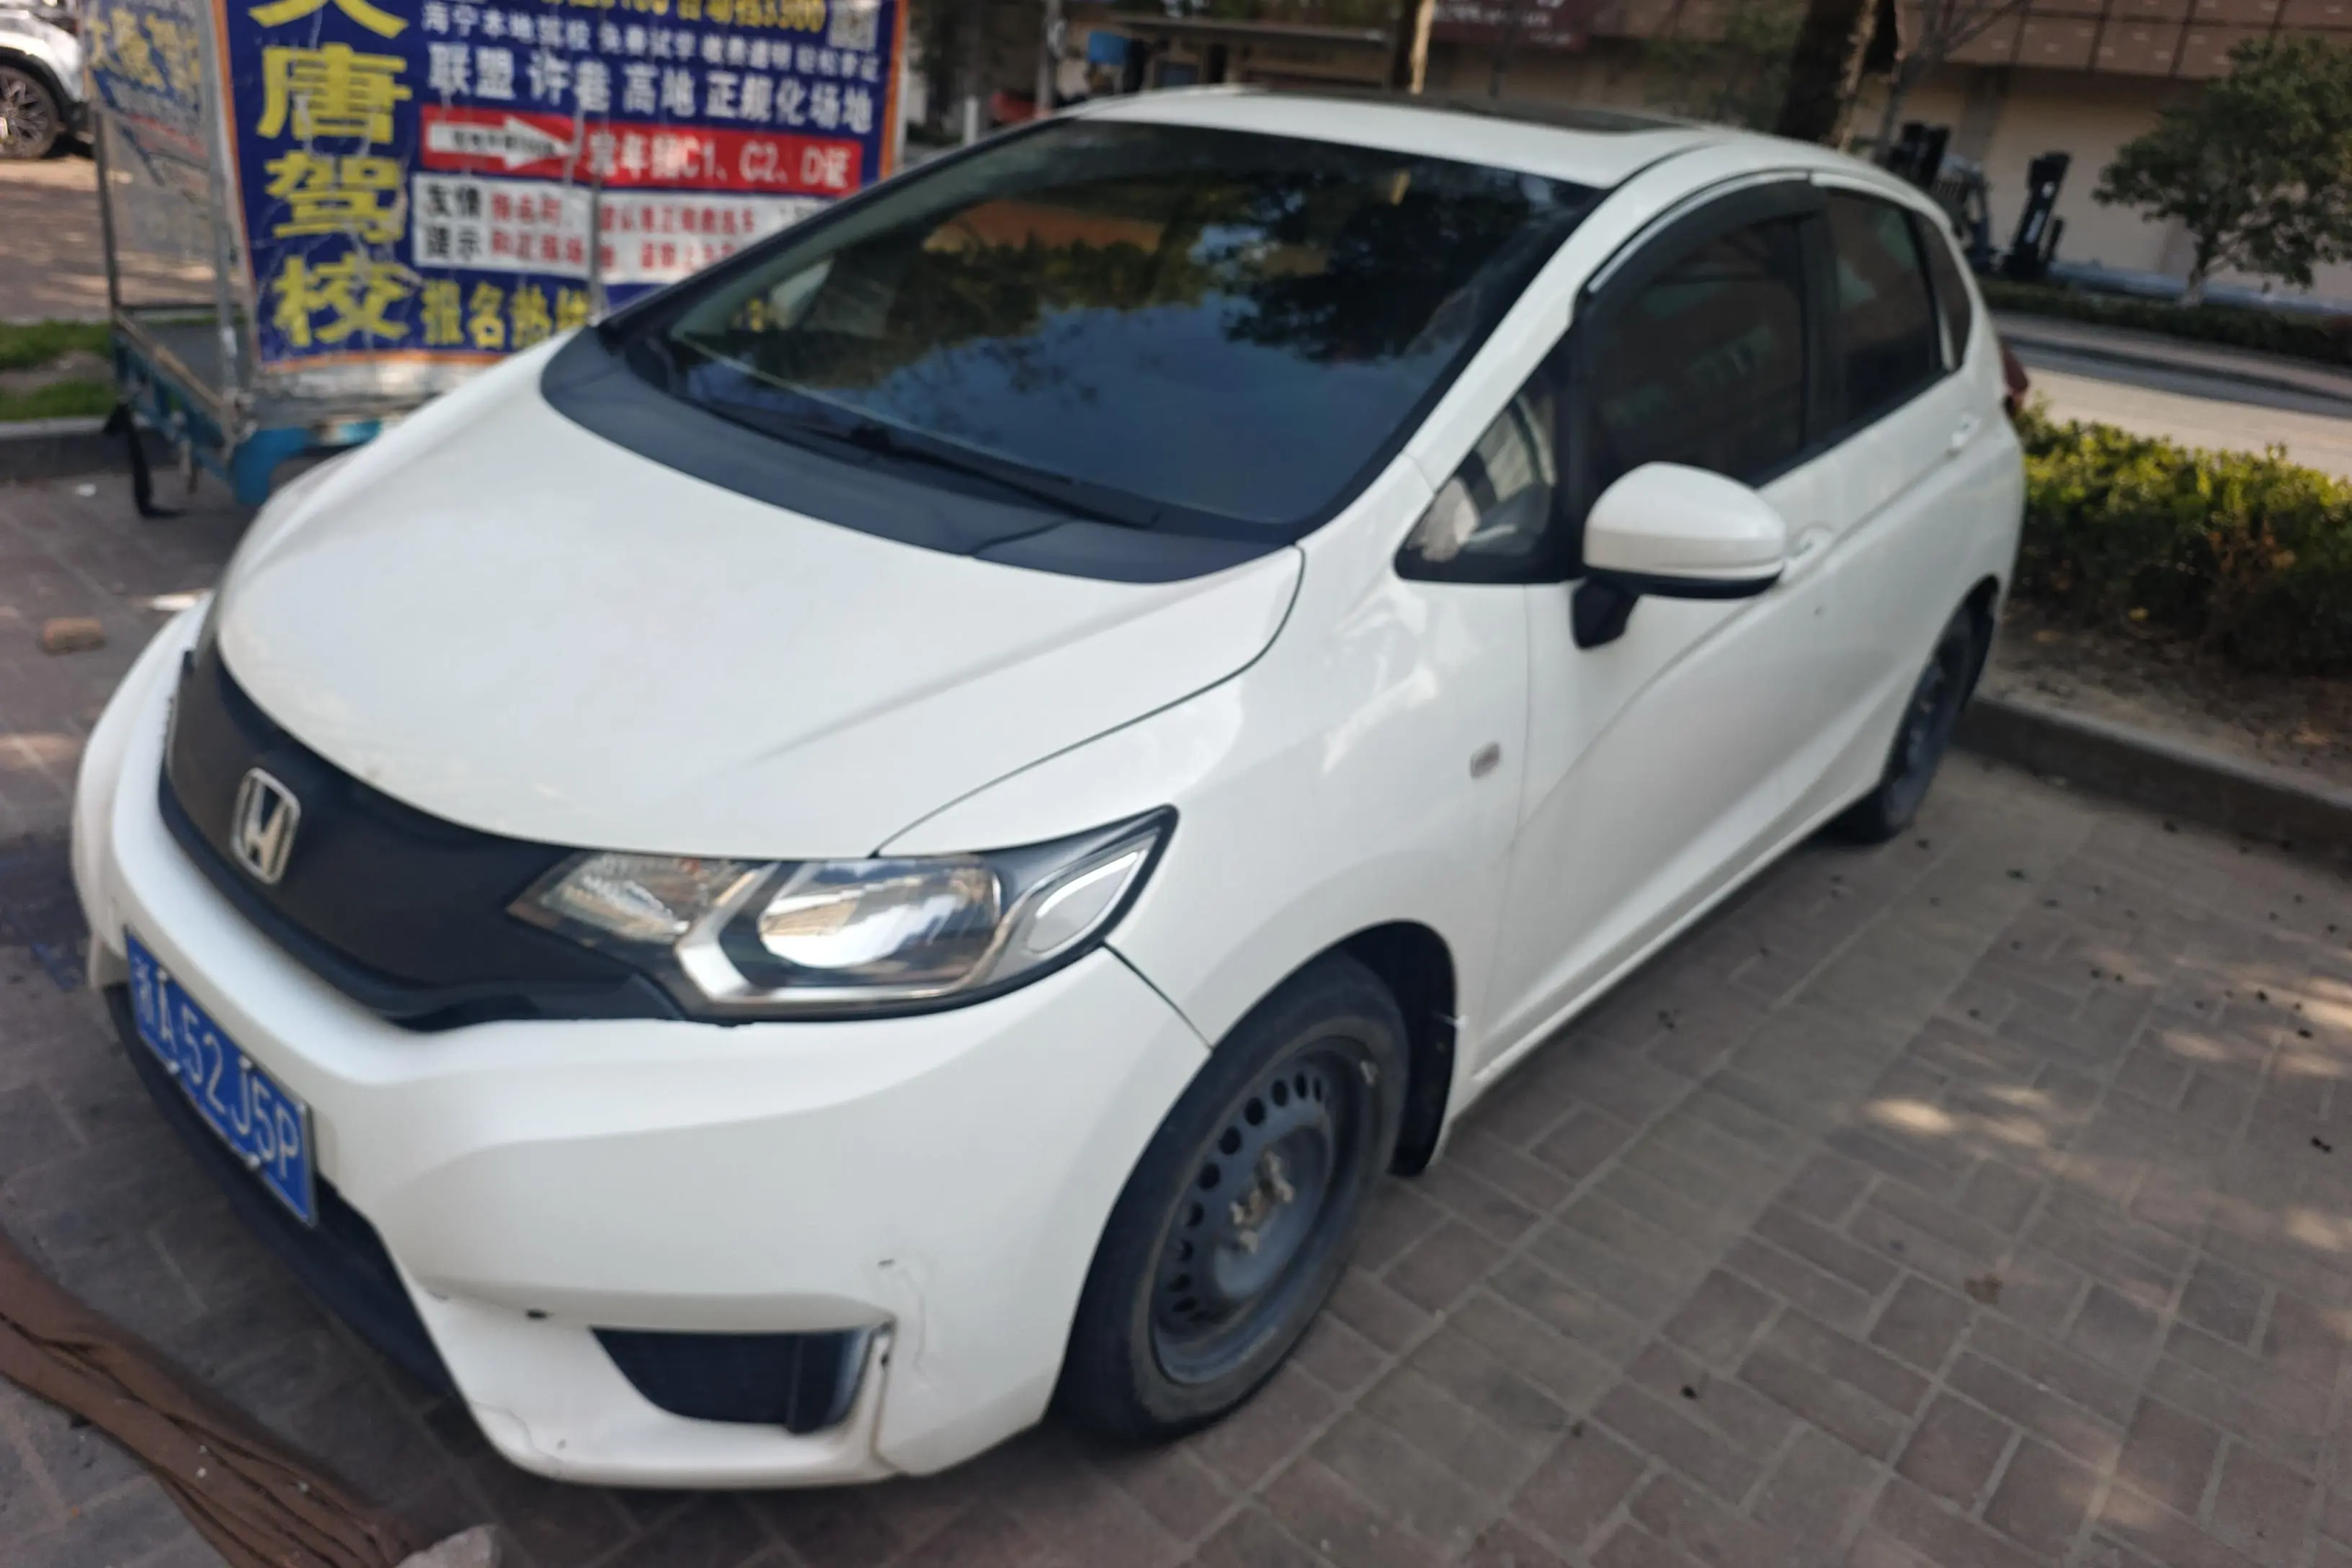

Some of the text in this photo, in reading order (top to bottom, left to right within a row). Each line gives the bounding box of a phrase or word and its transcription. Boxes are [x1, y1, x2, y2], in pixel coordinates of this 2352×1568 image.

[421, 1, 592, 51] 海宁本地驾校
[427, 41, 515, 100] 联盟
[704, 71, 873, 135] 正规化场地
